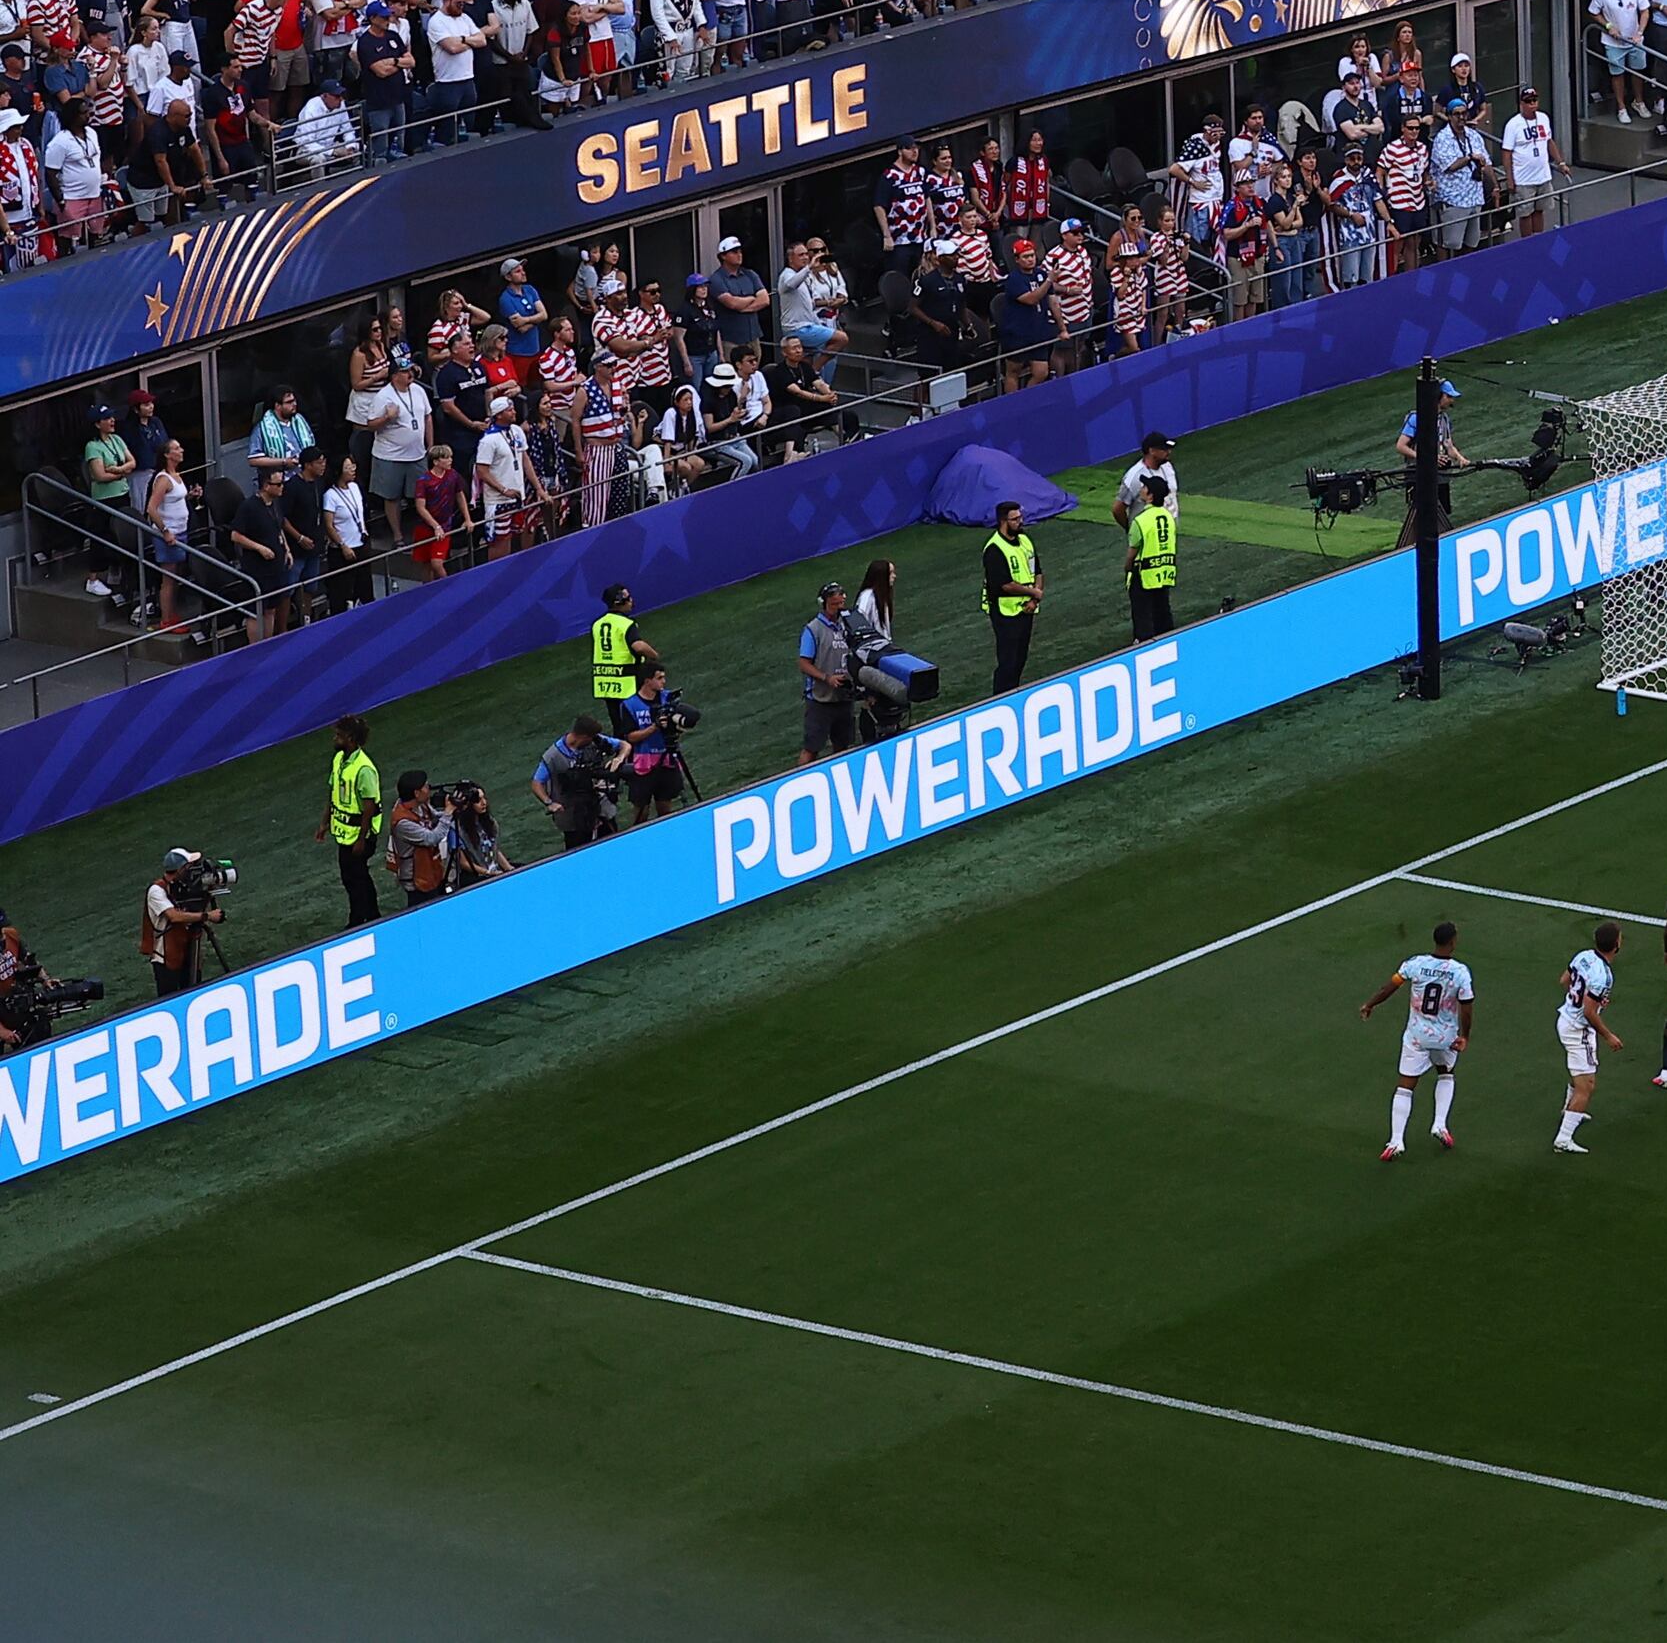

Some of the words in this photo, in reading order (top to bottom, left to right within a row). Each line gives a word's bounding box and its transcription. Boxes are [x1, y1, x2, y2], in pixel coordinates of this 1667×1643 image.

[575, 63, 869, 204] SEATTLE
[904, 186, 923, 196] USA
[943, 189, 965, 198] USA
[713, 641, 1183, 904] POWERADE
[1420, 982, 1444, 1018] 8
